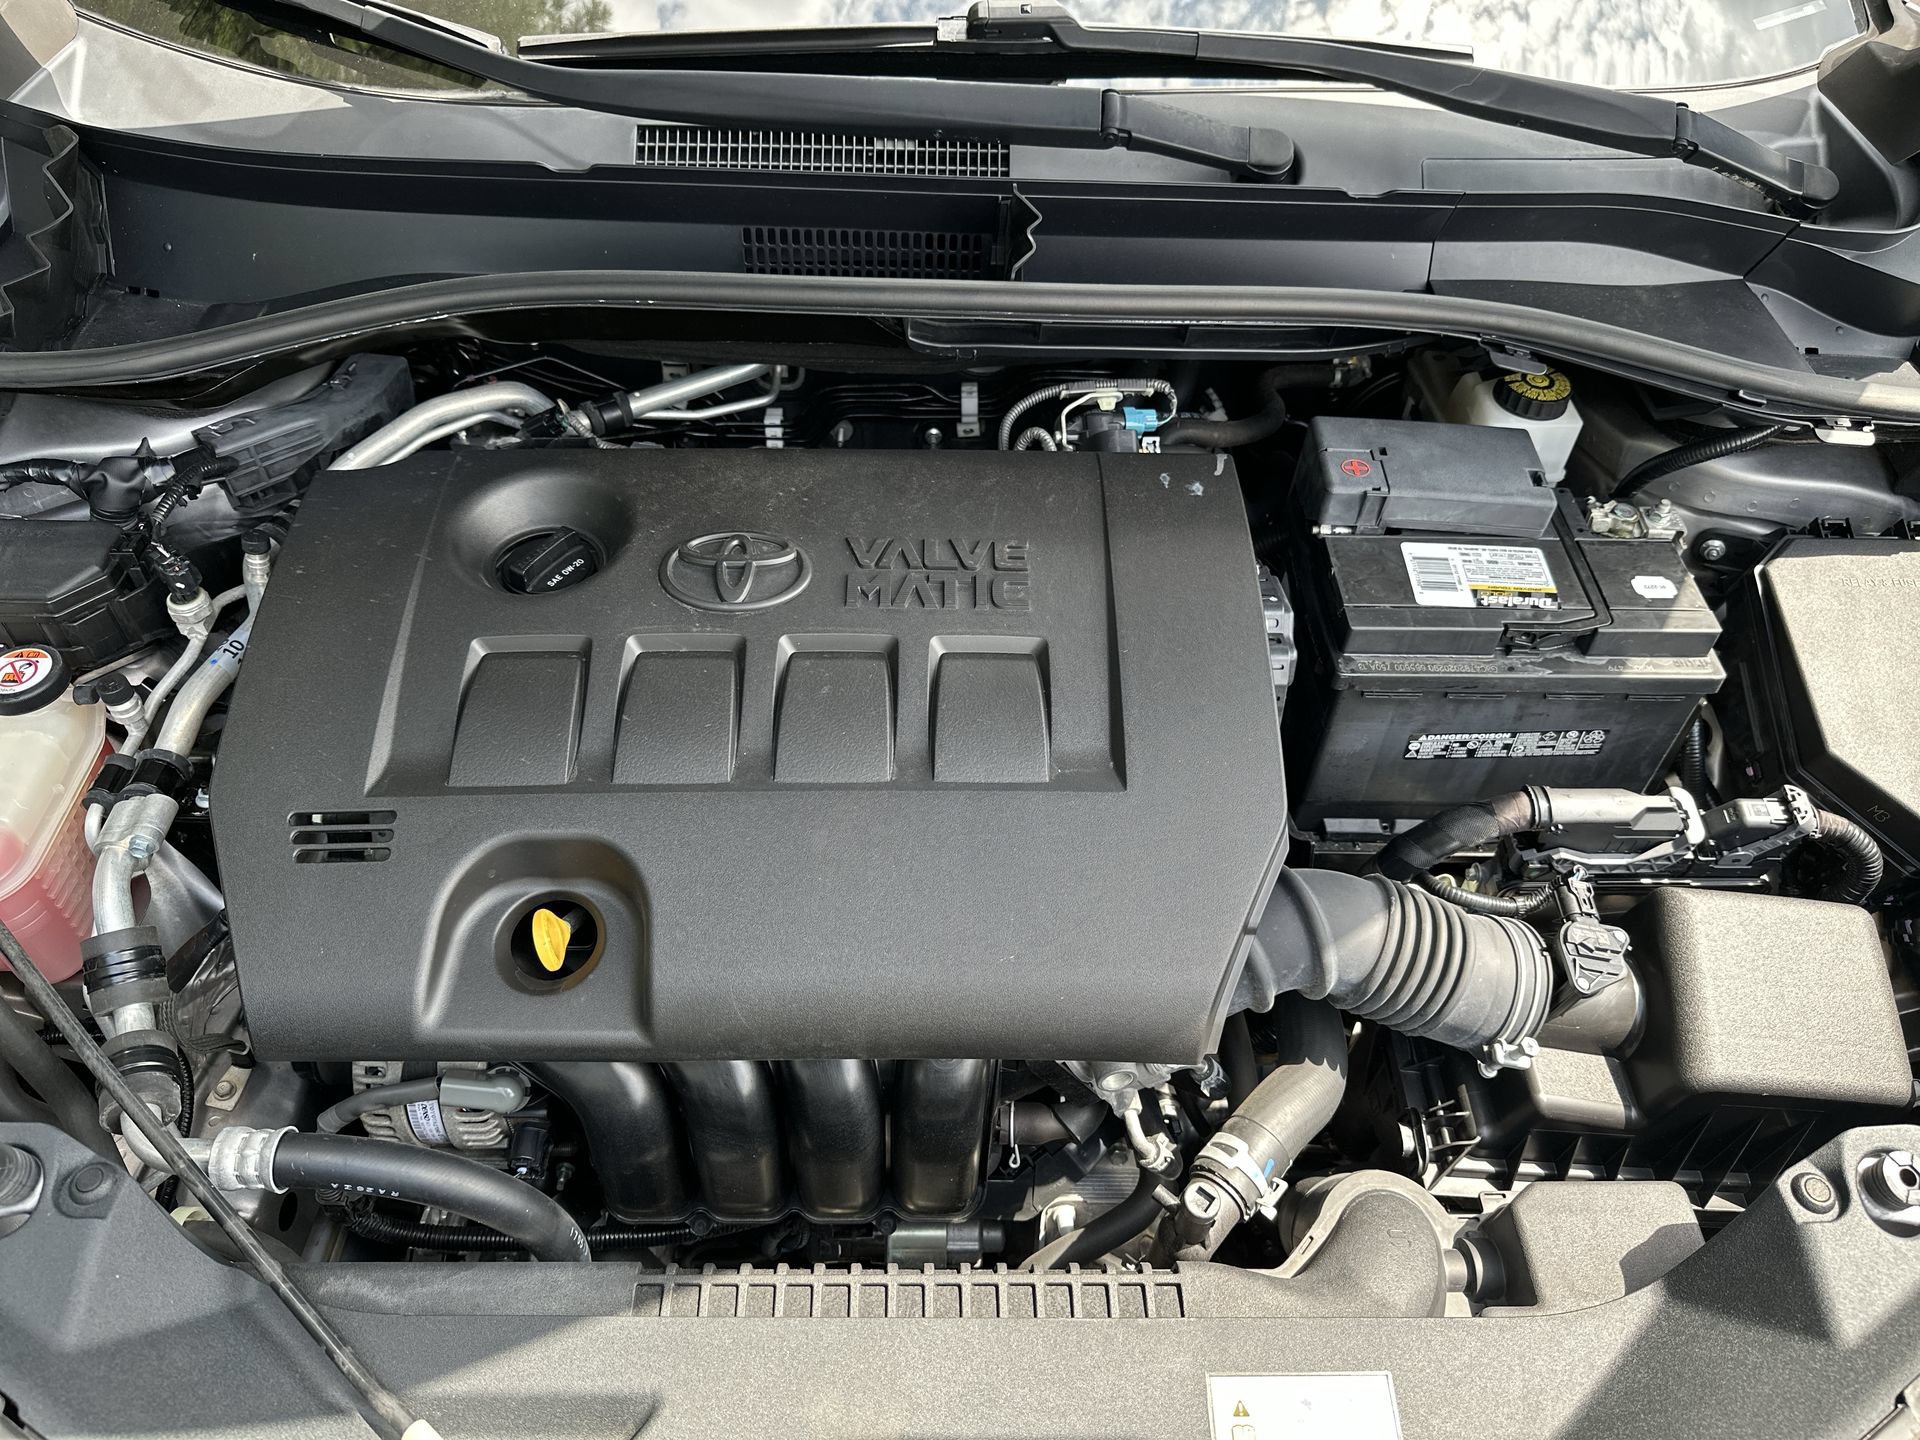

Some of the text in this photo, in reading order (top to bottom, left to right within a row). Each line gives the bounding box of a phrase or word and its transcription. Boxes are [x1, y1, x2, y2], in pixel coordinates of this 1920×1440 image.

[845, 537, 1030, 571] VALVE
[546, 558, 585, 587] SAE 0W-20
[844, 572, 1031, 611] MATIC
[1480, 595, 1558, 609] Duralast
[223, 640, 245, 659] 10
[1427, 732, 1512, 741] DANGER/POISON
